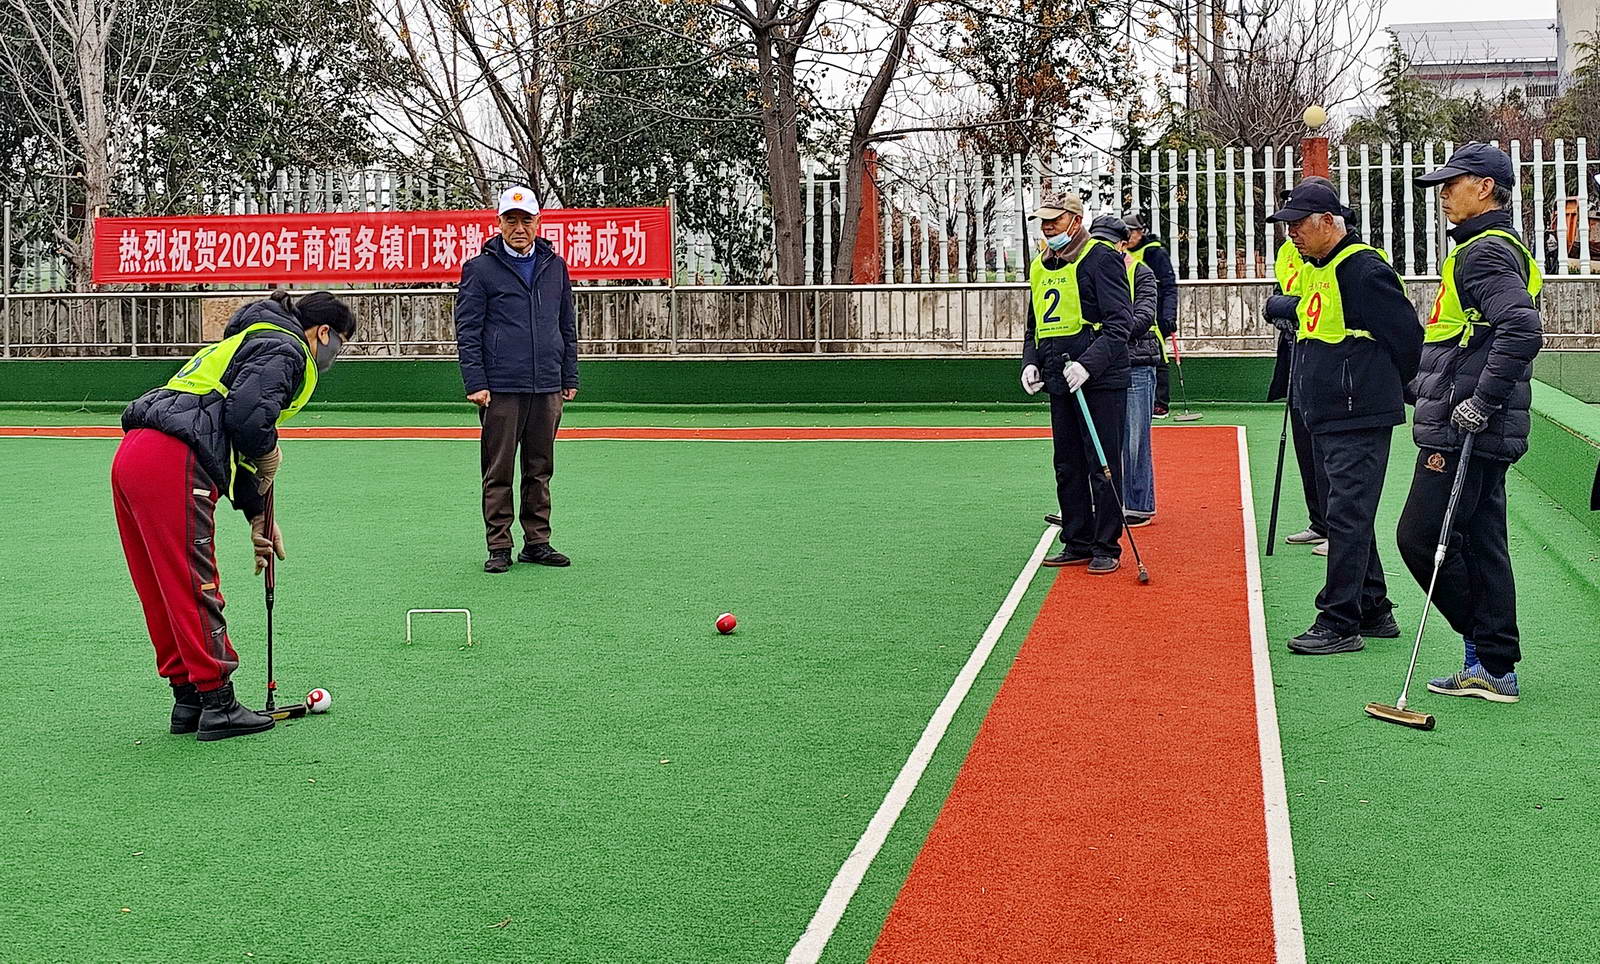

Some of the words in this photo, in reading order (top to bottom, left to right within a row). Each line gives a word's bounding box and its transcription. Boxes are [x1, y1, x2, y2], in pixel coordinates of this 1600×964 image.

[118, 219, 647, 273] 热烈祝贺2026年商酒务镇门球邀圆满成功
[1043, 288, 1061, 323] 2
[1306, 291, 1322, 333] 9
